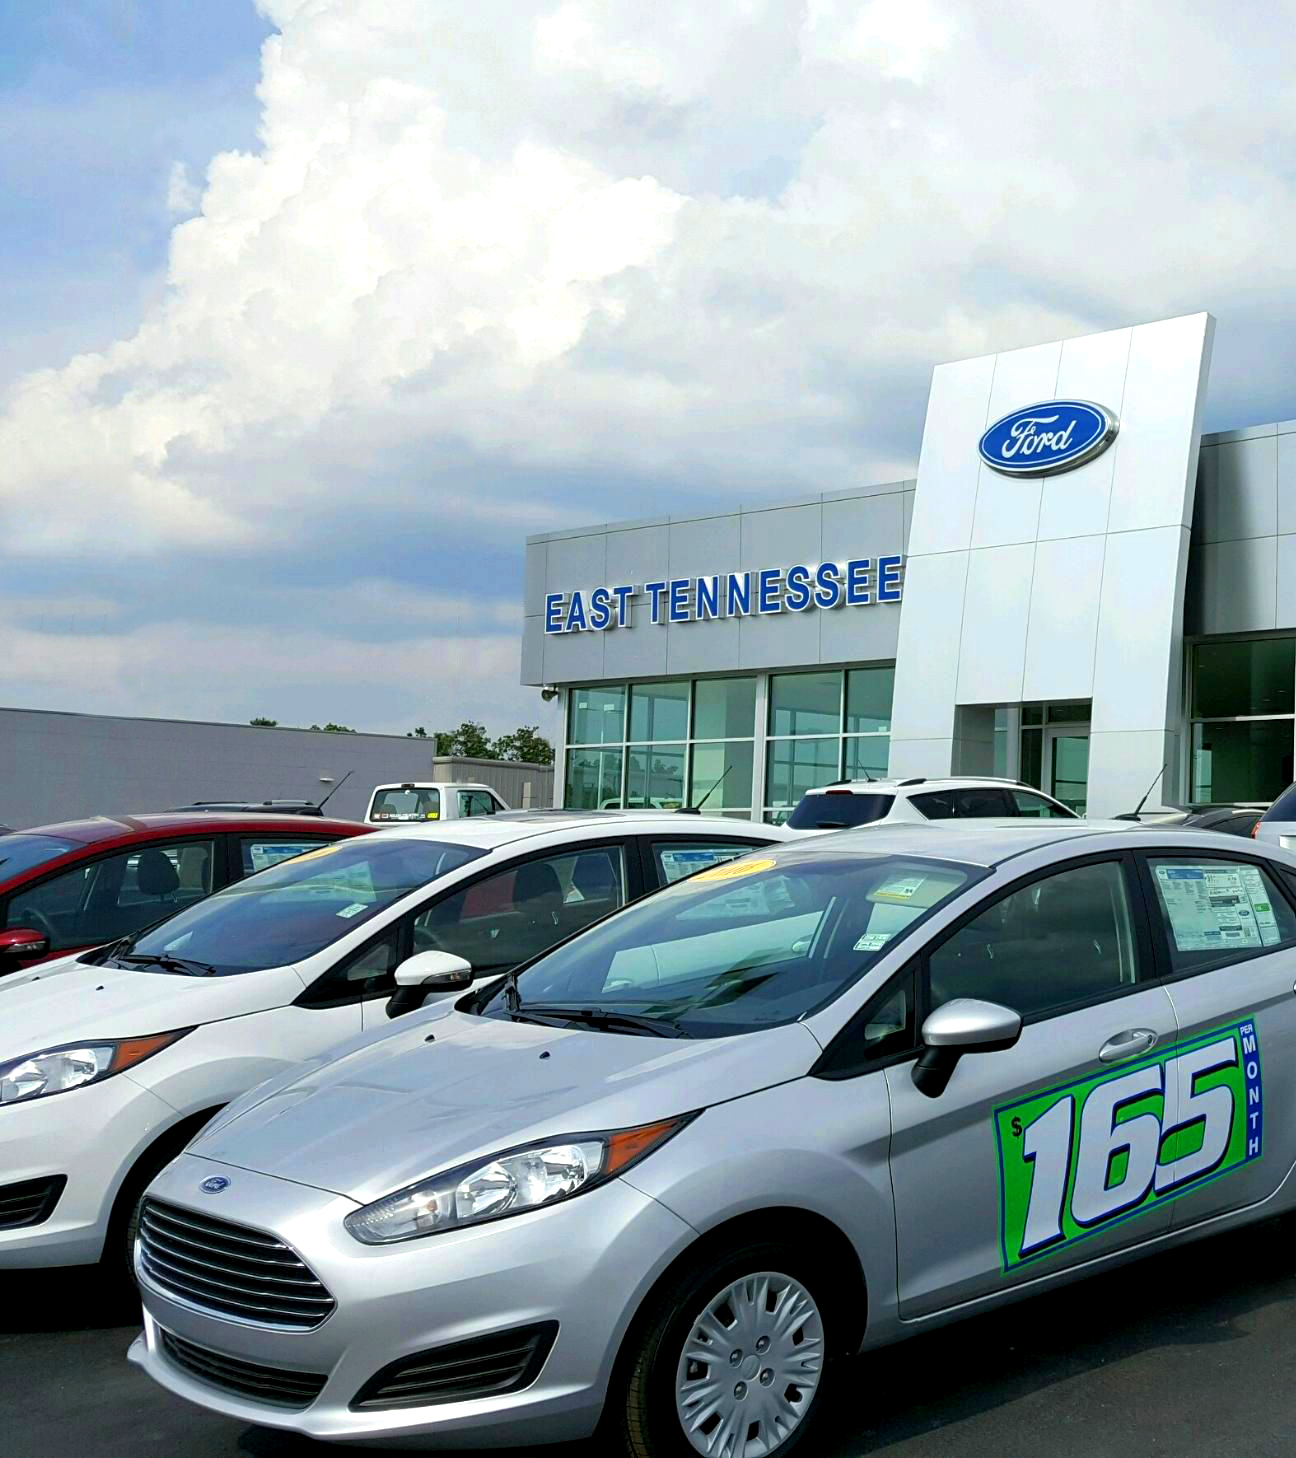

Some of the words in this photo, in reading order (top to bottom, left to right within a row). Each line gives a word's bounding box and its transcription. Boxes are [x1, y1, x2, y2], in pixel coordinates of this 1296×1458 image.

[1001, 414, 1077, 459] Ford
[544, 585, 634, 635] EAST
[644, 554, 902, 625] TENNESSEE
[1240, 1024, 1253, 1036] PER
[1242, 1034, 1260, 1157] MONTH
